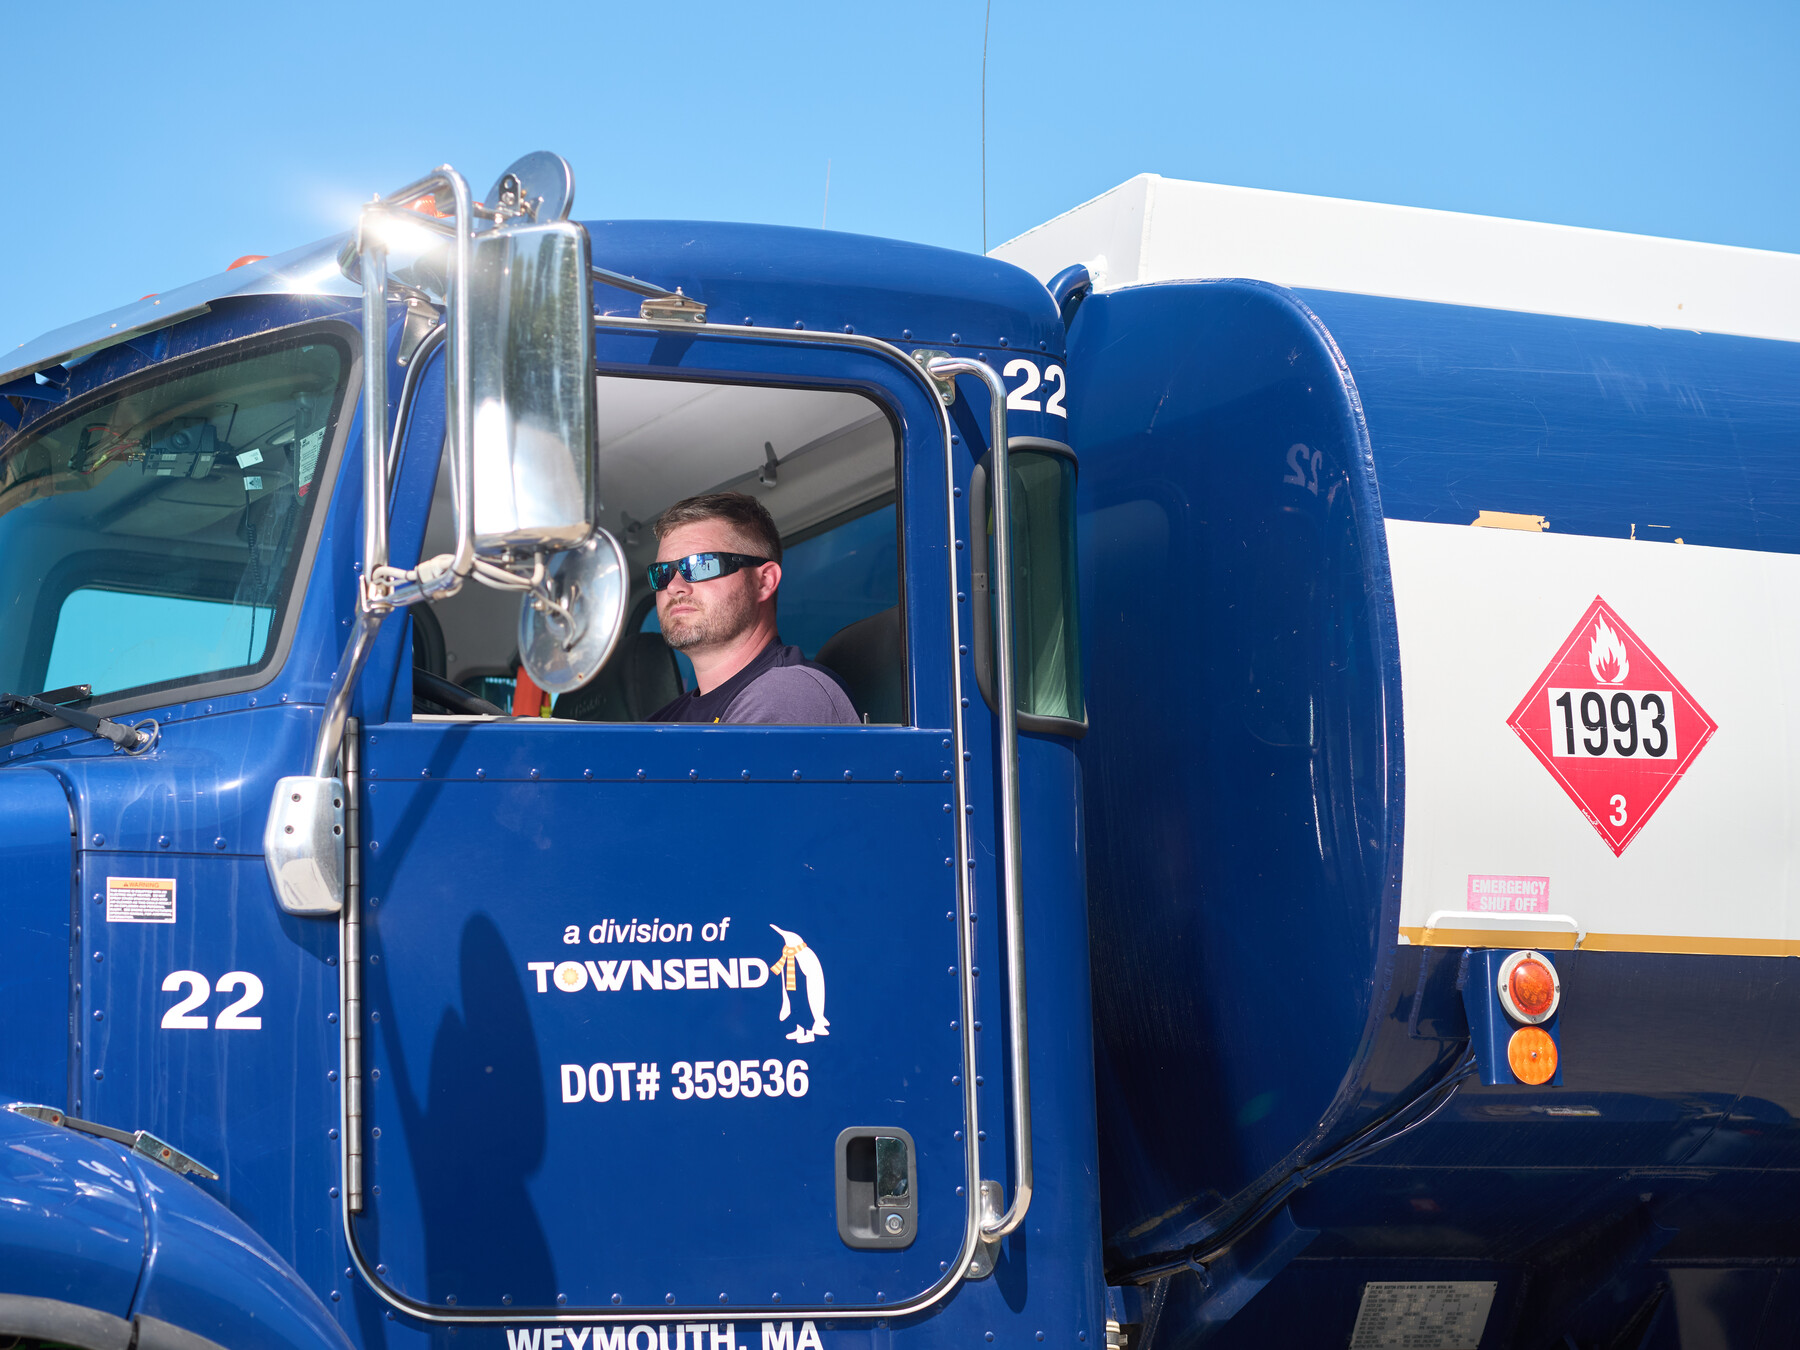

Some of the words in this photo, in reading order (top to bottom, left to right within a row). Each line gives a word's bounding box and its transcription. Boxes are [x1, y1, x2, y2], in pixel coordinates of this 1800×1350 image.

[1003, 358, 1067, 419] 22
[1556, 691, 1668, 757] 1993
[1609, 794, 1628, 827] 3
[1472, 879, 1547, 896] EMERGENCY
[1480, 897, 1512, 911] SHUT
[1514, 897, 1538, 912] OFF
[563, 924, 581, 944] a
[588, 918, 693, 944] division
[701, 917, 731, 942] of
[527, 957, 769, 993] TOWNSEND
[160, 969, 264, 1031] 22
[560, 1062, 661, 1103] DOT#
[671, 1059, 810, 1100] 359536
[761, 1321, 825, 1350] MA
